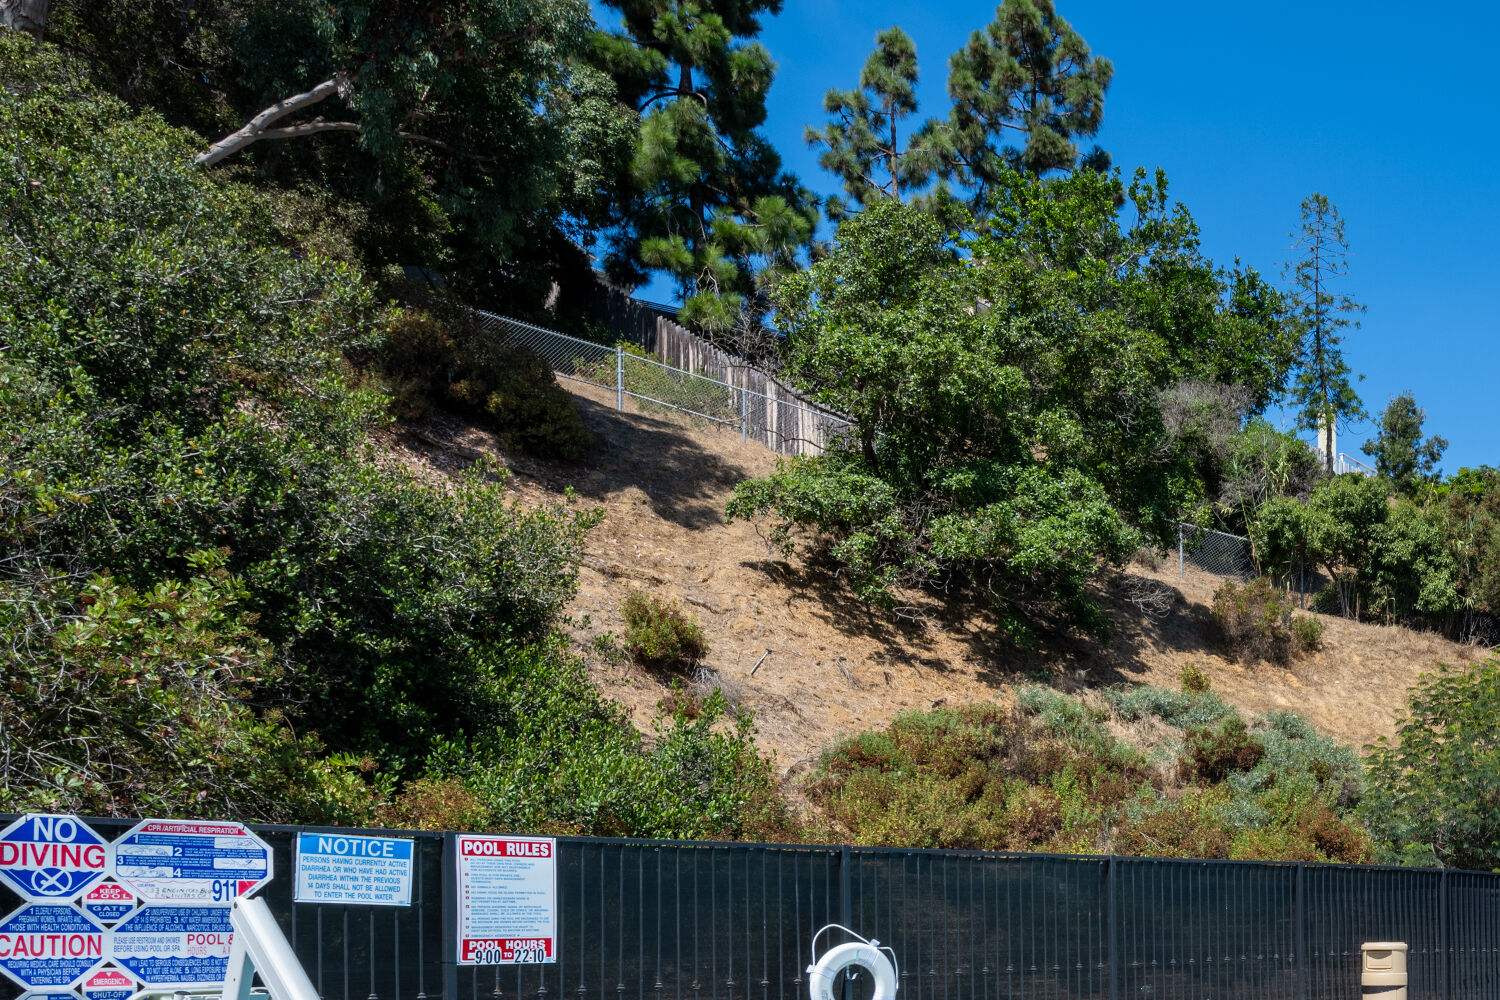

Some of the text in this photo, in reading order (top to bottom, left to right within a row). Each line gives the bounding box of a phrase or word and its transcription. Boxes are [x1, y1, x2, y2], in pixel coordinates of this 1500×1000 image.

[34, 817, 77, 842] NO
[174, 847, 183, 857] 2
[318, 838, 394, 858] NOTICE
[464, 841, 549, 856] POOL RULES
[0, 842, 106, 868] DIVING
[117, 856, 124, 865] 3
[302, 856, 330, 864] PERSONS
[354, 859, 386, 867] CURRENTLY
[174, 868, 182, 878] 4
[302, 864, 330, 872] DIARRHEA
[308, 874, 338, 882] DIARRHEA
[213, 880, 237, 902] 911
[187, 934, 224, 945] POOL
[469, 940, 546, 950] POOL HOURS
[0, 934, 102, 958] CAUTION
[187, 946, 207, 955] HOURS
